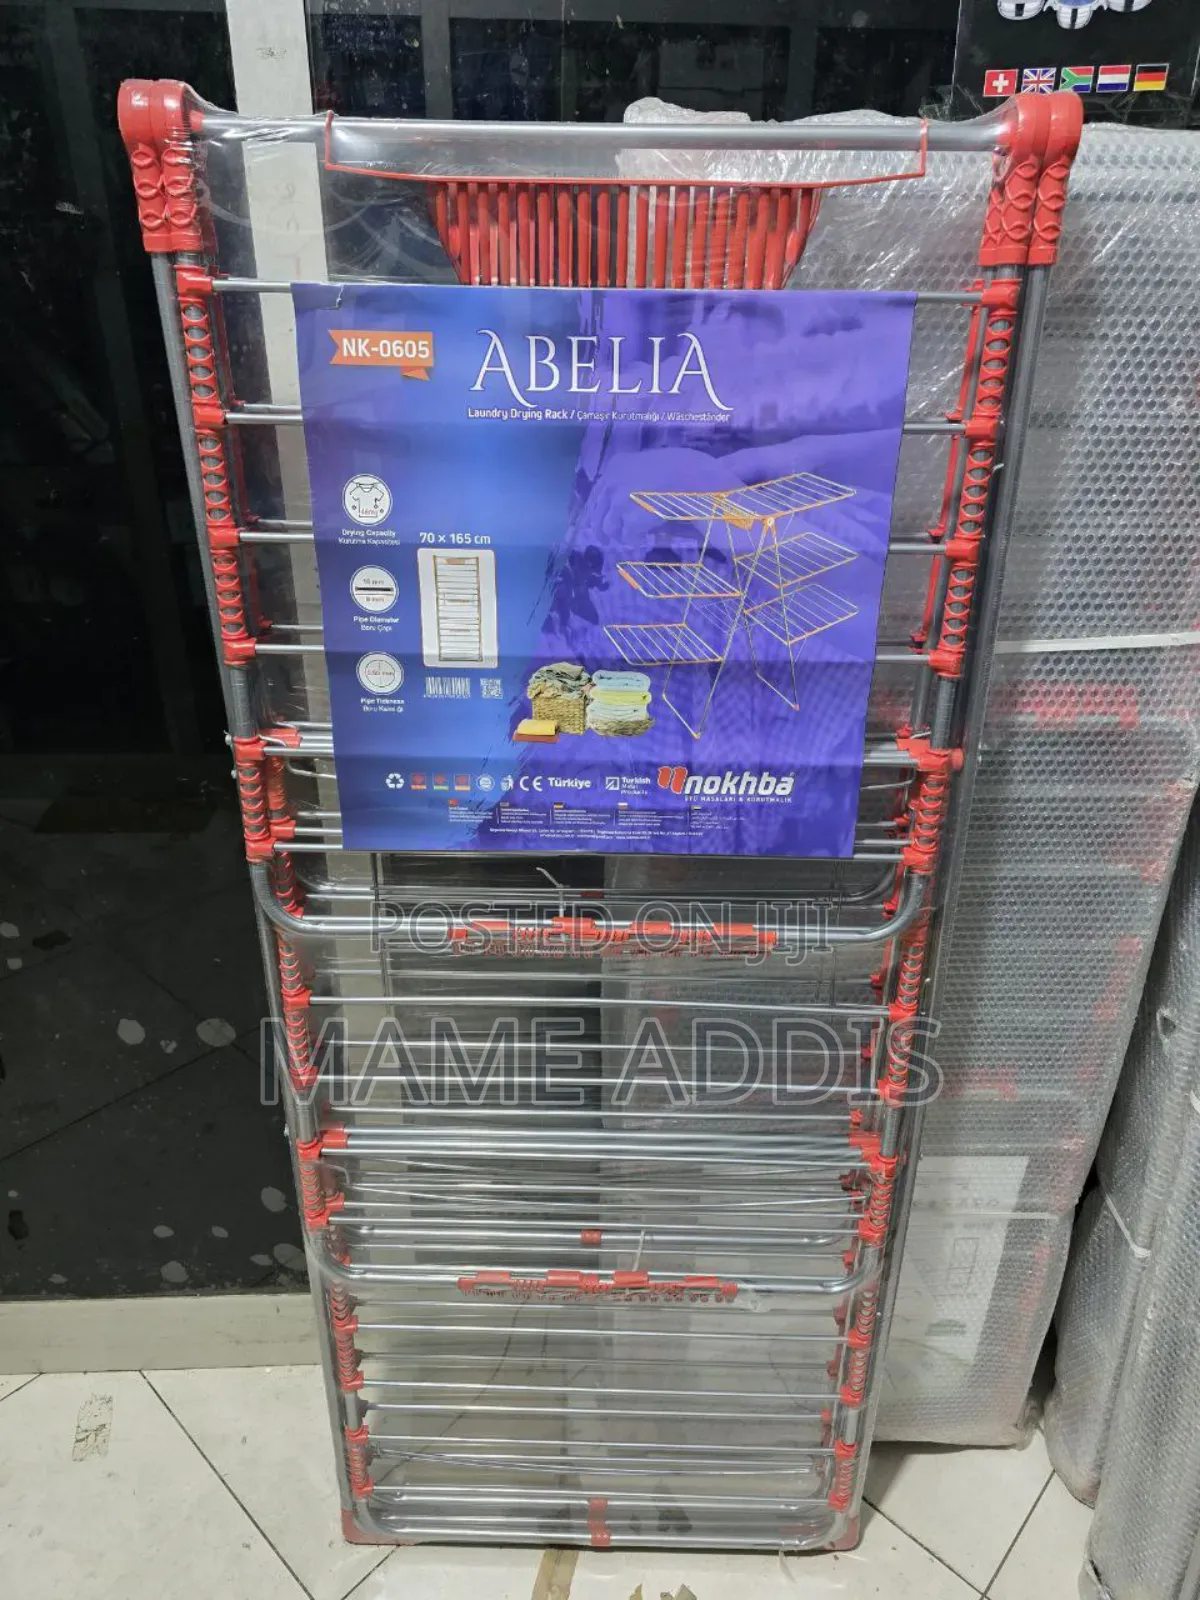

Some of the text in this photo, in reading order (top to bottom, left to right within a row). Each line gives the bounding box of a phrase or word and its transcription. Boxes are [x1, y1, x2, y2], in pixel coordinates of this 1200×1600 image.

[342, 337, 430, 359] NK-0605
[468, 329, 734, 411] ABELIA
[467, 407, 508, 420] Laundry
[510, 408, 542, 420] Drying
[545, 409, 568, 419] Rack
[419, 532, 435, 544] 70
[449, 533, 472, 545] 165
[474, 535, 491, 545] cm
[547, 777, 592, 790] Türkiye
[621, 776, 651, 785] Turkish
[684, 771, 796, 796] nokhba
